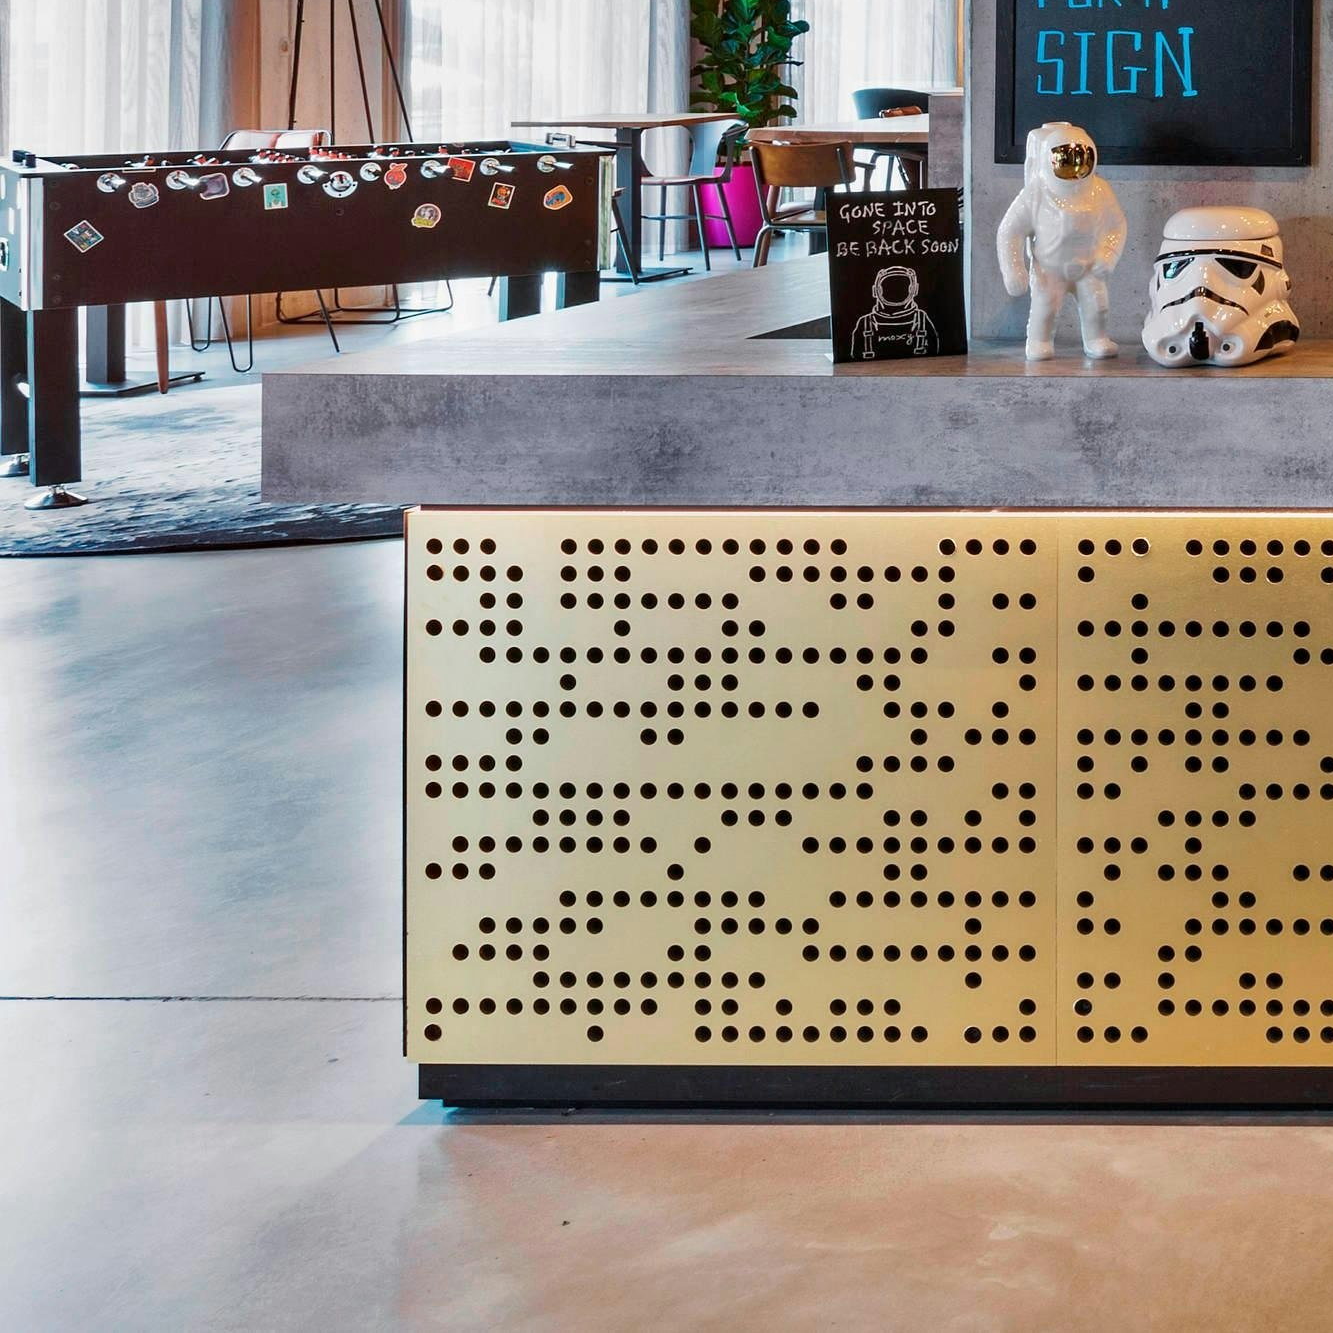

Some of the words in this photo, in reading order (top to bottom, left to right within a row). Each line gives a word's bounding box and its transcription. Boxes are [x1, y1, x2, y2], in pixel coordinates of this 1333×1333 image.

[1036, 27, 1198, 97] SIGN
[839, 202, 886, 223] GONE
[893, 200, 937, 217] INTO
[872, 219, 930, 235] SPACE
[836, 241, 860, 257] BE
[866, 238, 915, 257] BACK
[921, 238, 959, 255] SOON
